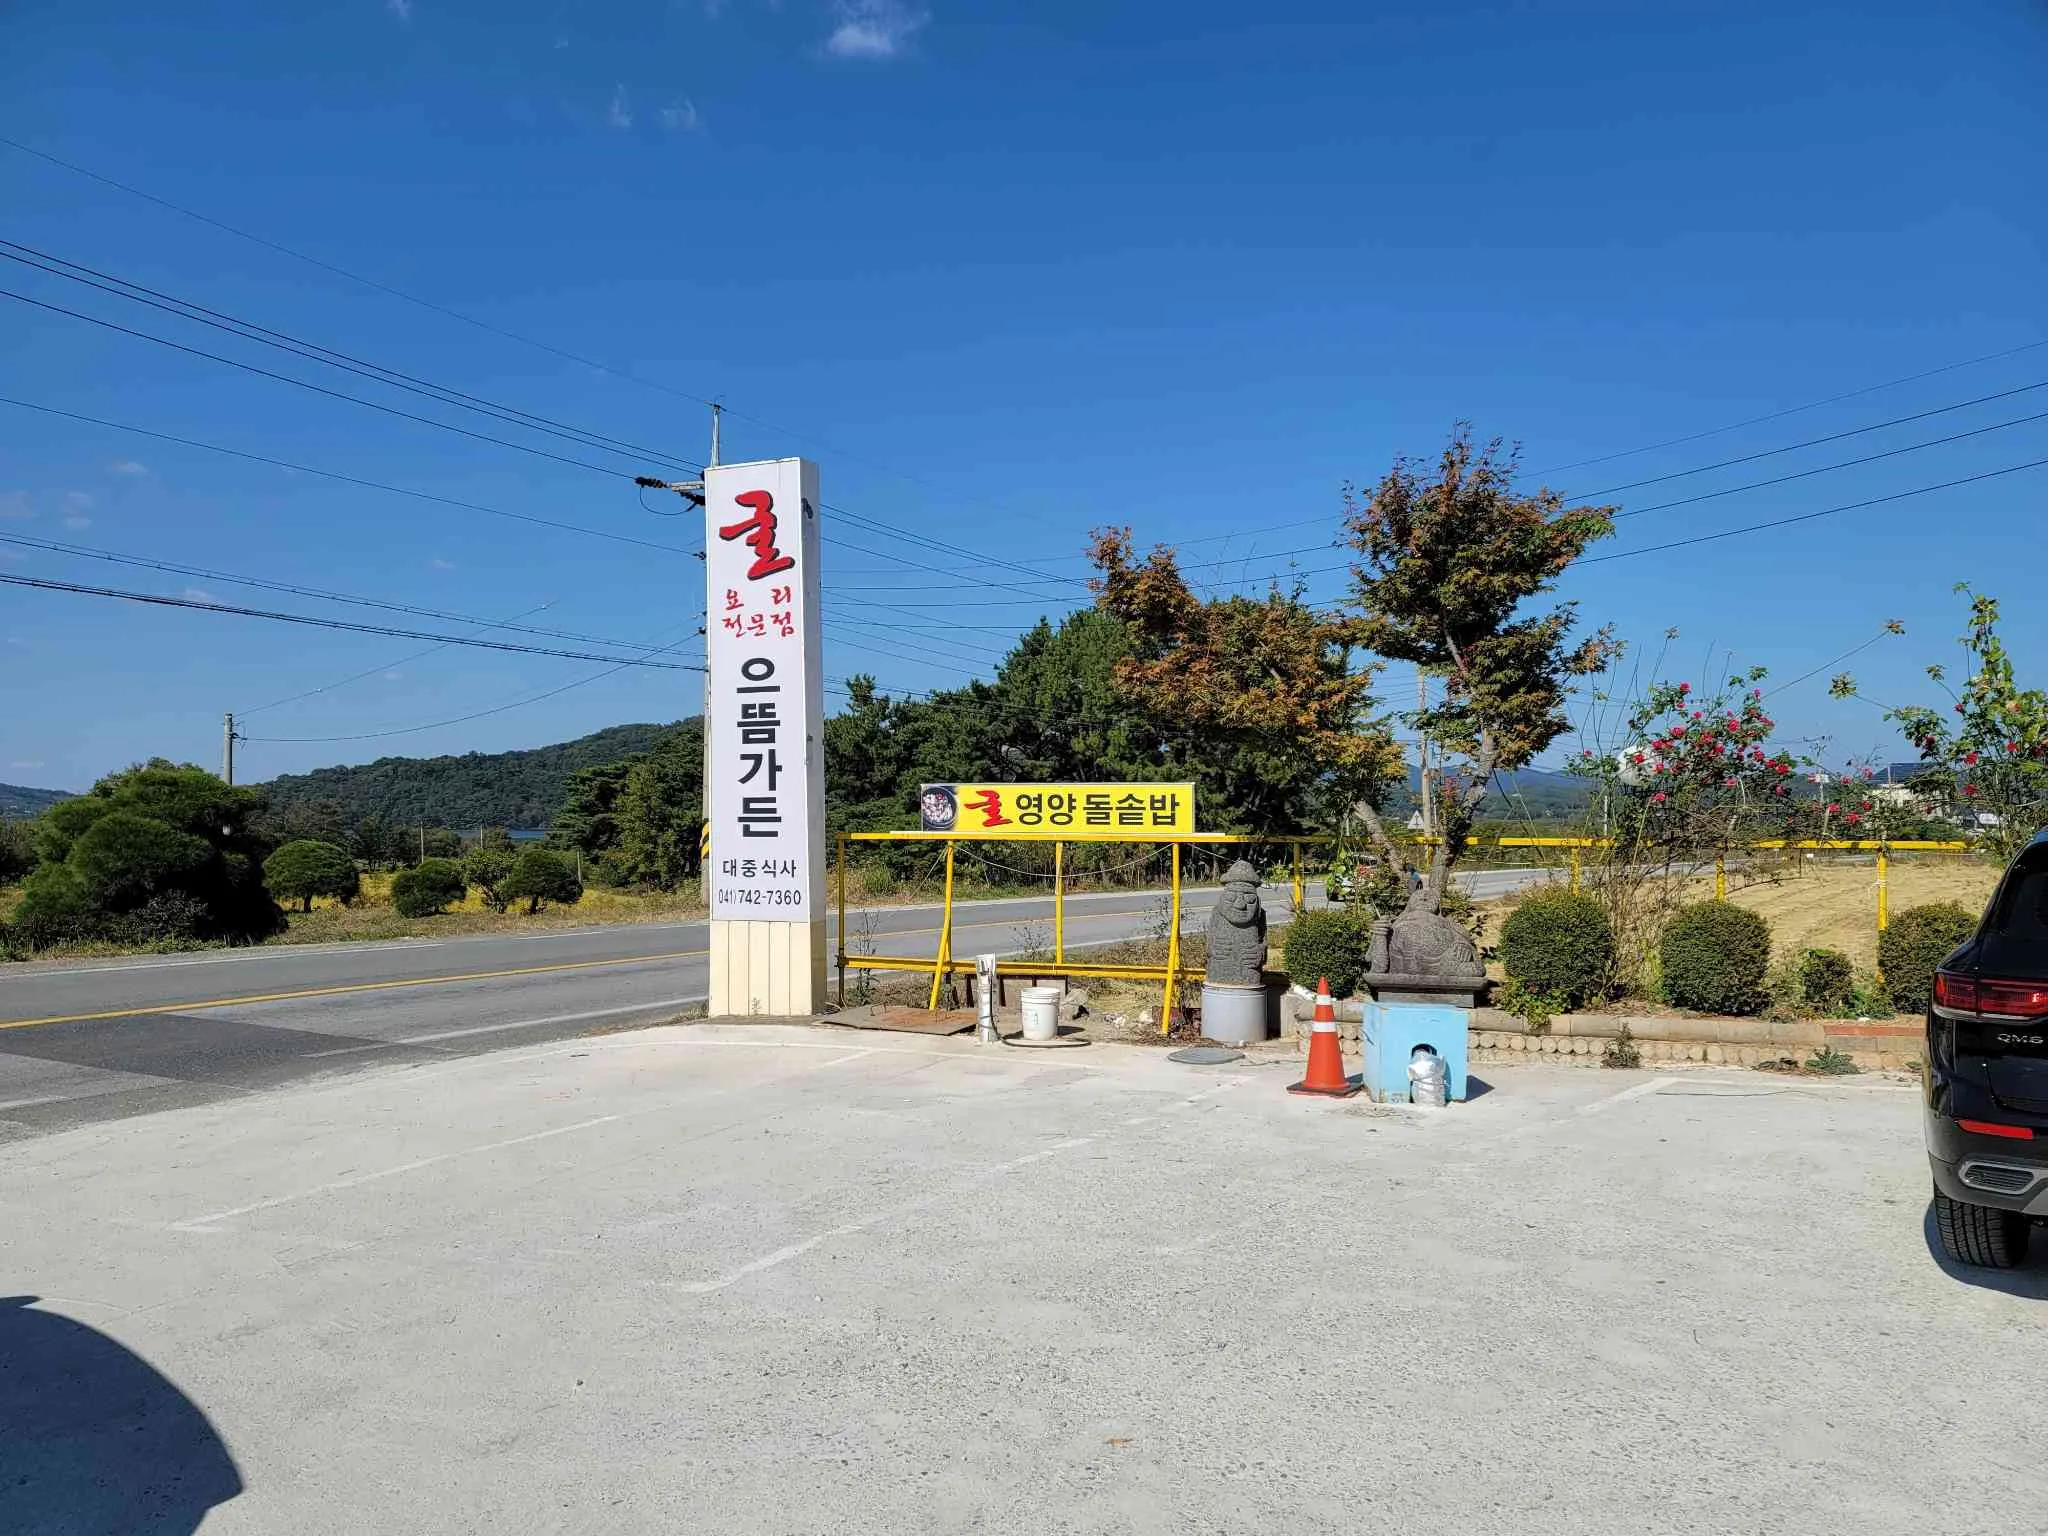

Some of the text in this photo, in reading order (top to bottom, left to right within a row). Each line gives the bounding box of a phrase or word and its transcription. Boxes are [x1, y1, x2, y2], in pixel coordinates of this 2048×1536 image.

[722, 612, 795, 638] 전문점
[736, 657, 783, 838] 으뜸가든
[722, 858, 797, 878] 대중식사
